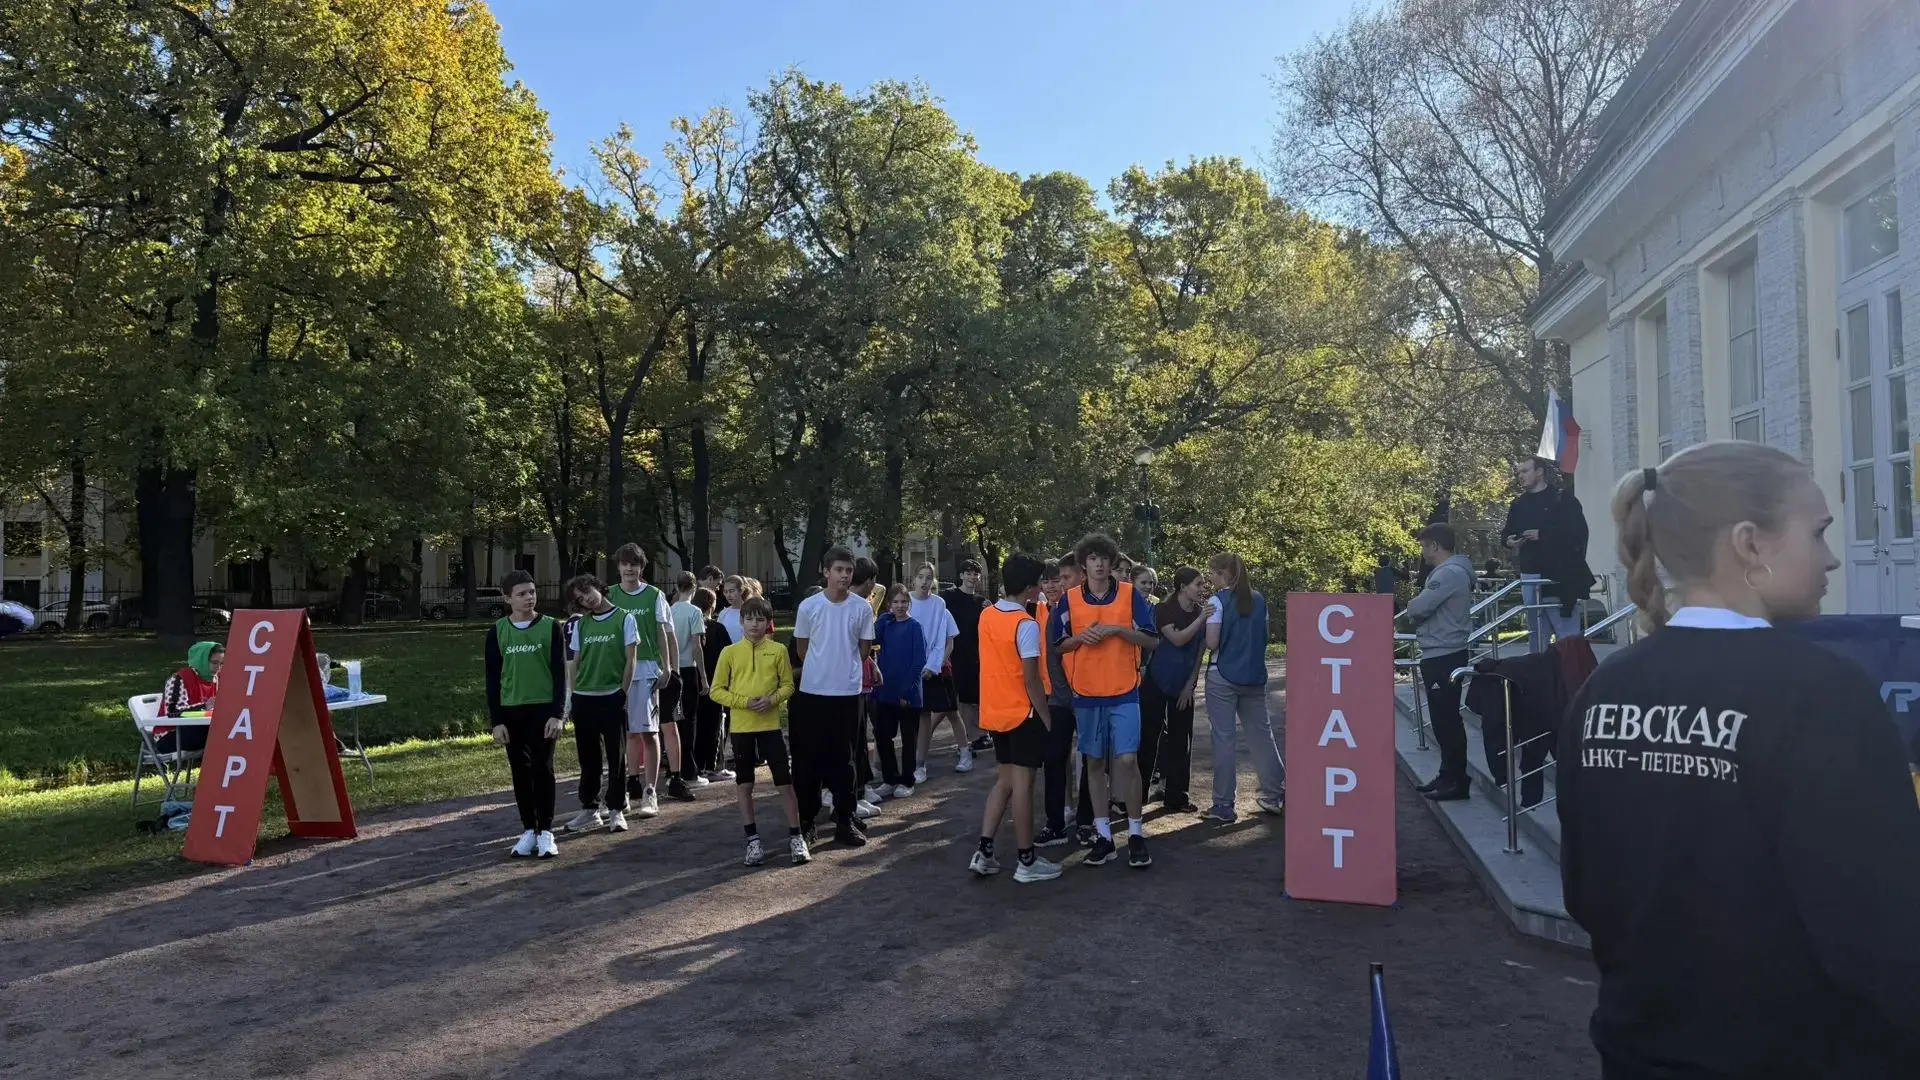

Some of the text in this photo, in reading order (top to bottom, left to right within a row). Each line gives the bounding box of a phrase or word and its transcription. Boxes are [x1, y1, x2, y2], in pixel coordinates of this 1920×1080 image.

[214, 620, 275, 838] СТАРТ
[1317, 604, 1357, 868] СТАРТ
[1582, 704, 1748, 751] НЕВСКАЯ
[1582, 748, 1739, 782] НКТ-ПЕТЕРБУРГ
